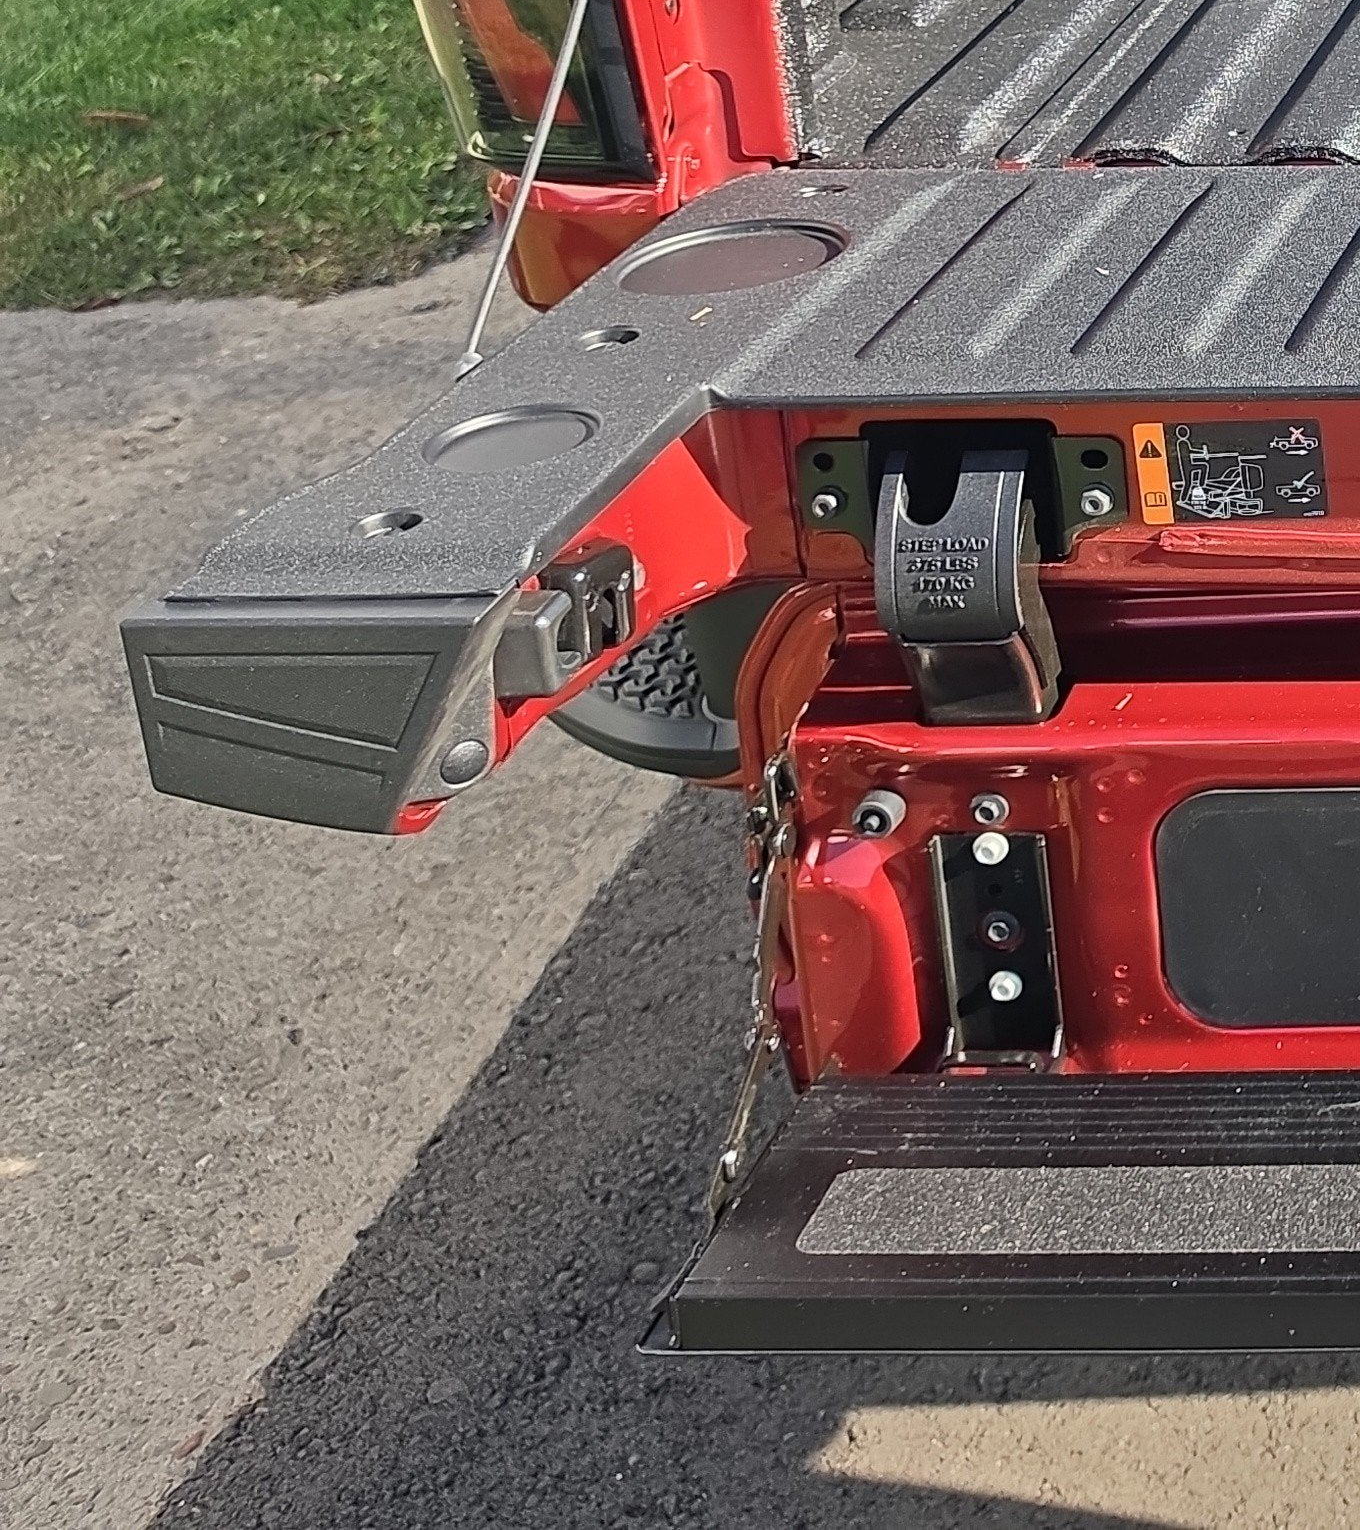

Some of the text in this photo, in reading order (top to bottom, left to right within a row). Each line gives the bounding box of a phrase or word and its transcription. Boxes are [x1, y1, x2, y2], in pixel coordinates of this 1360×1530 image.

[899, 536, 990, 552] STEP LOAD
[908, 556, 979, 571] 375 LBS
[918, 576, 975, 591] 170 KG
[928, 595, 966, 609] MAX
